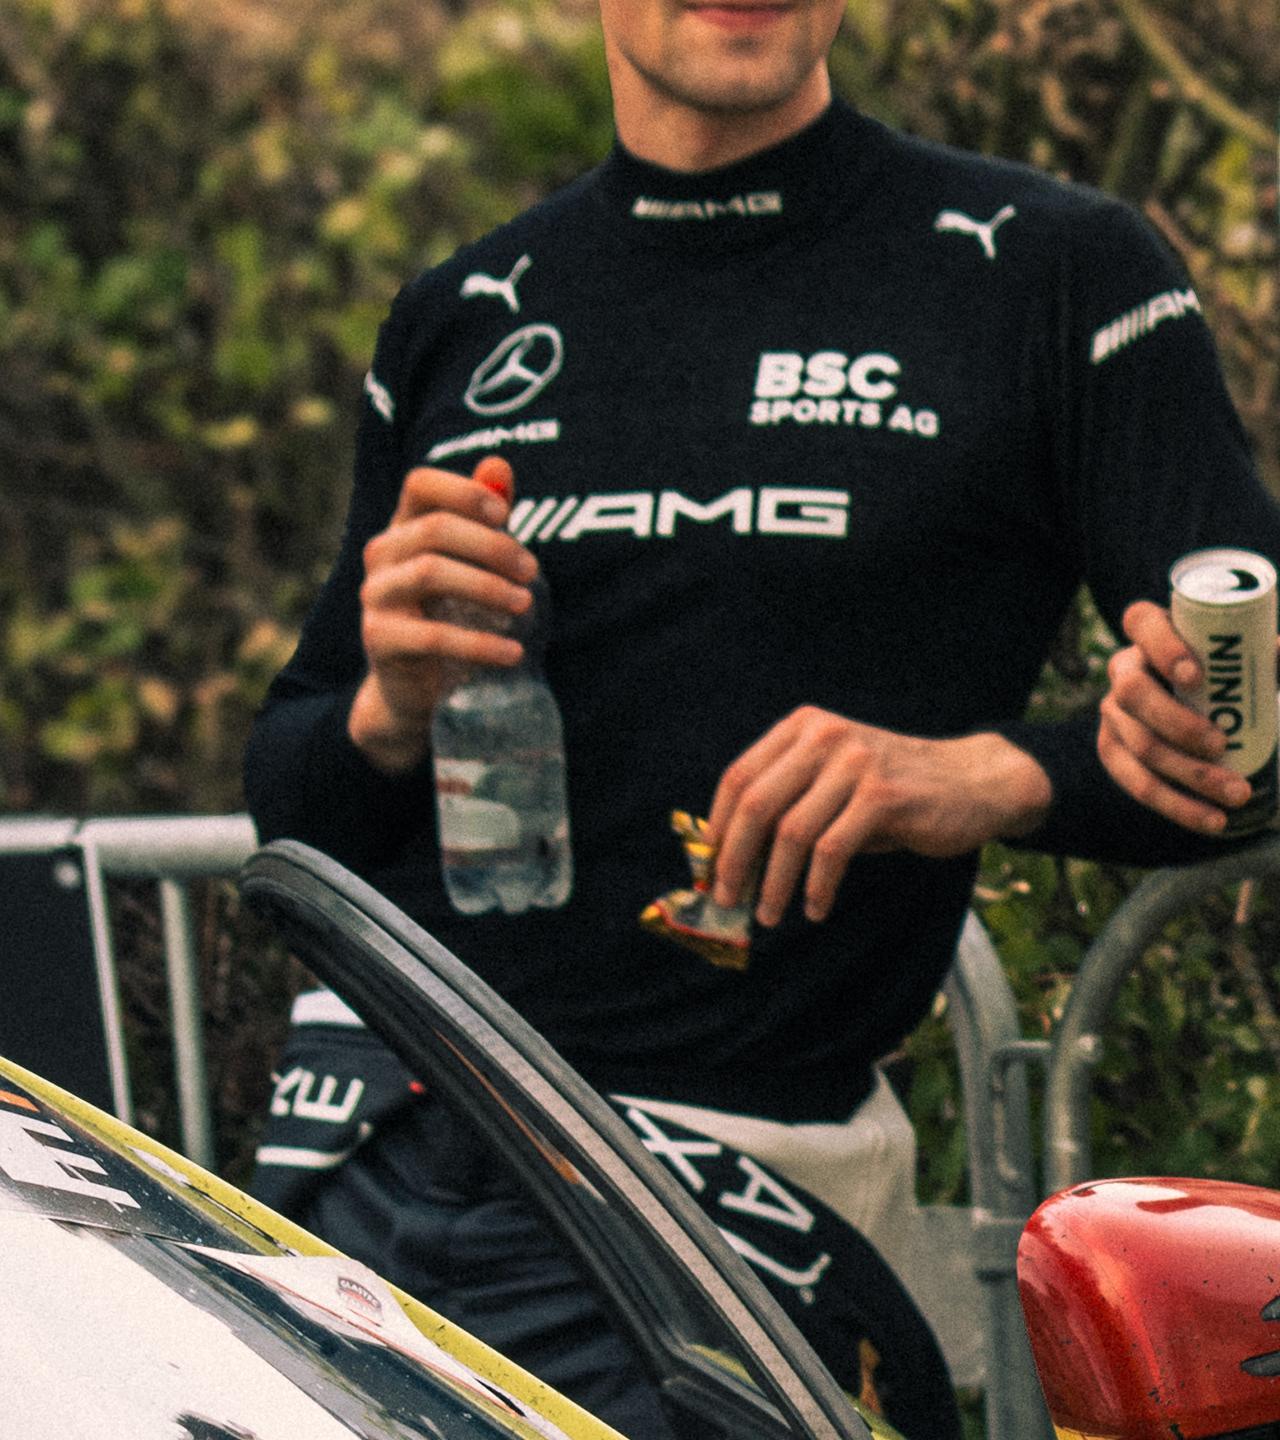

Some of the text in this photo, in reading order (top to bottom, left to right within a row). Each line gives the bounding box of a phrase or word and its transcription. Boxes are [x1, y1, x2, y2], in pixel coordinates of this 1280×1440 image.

[754, 350, 902, 400] BSC
[749, 398, 941, 438] SPORTS AG
[558, 486, 850, 539] AMG
